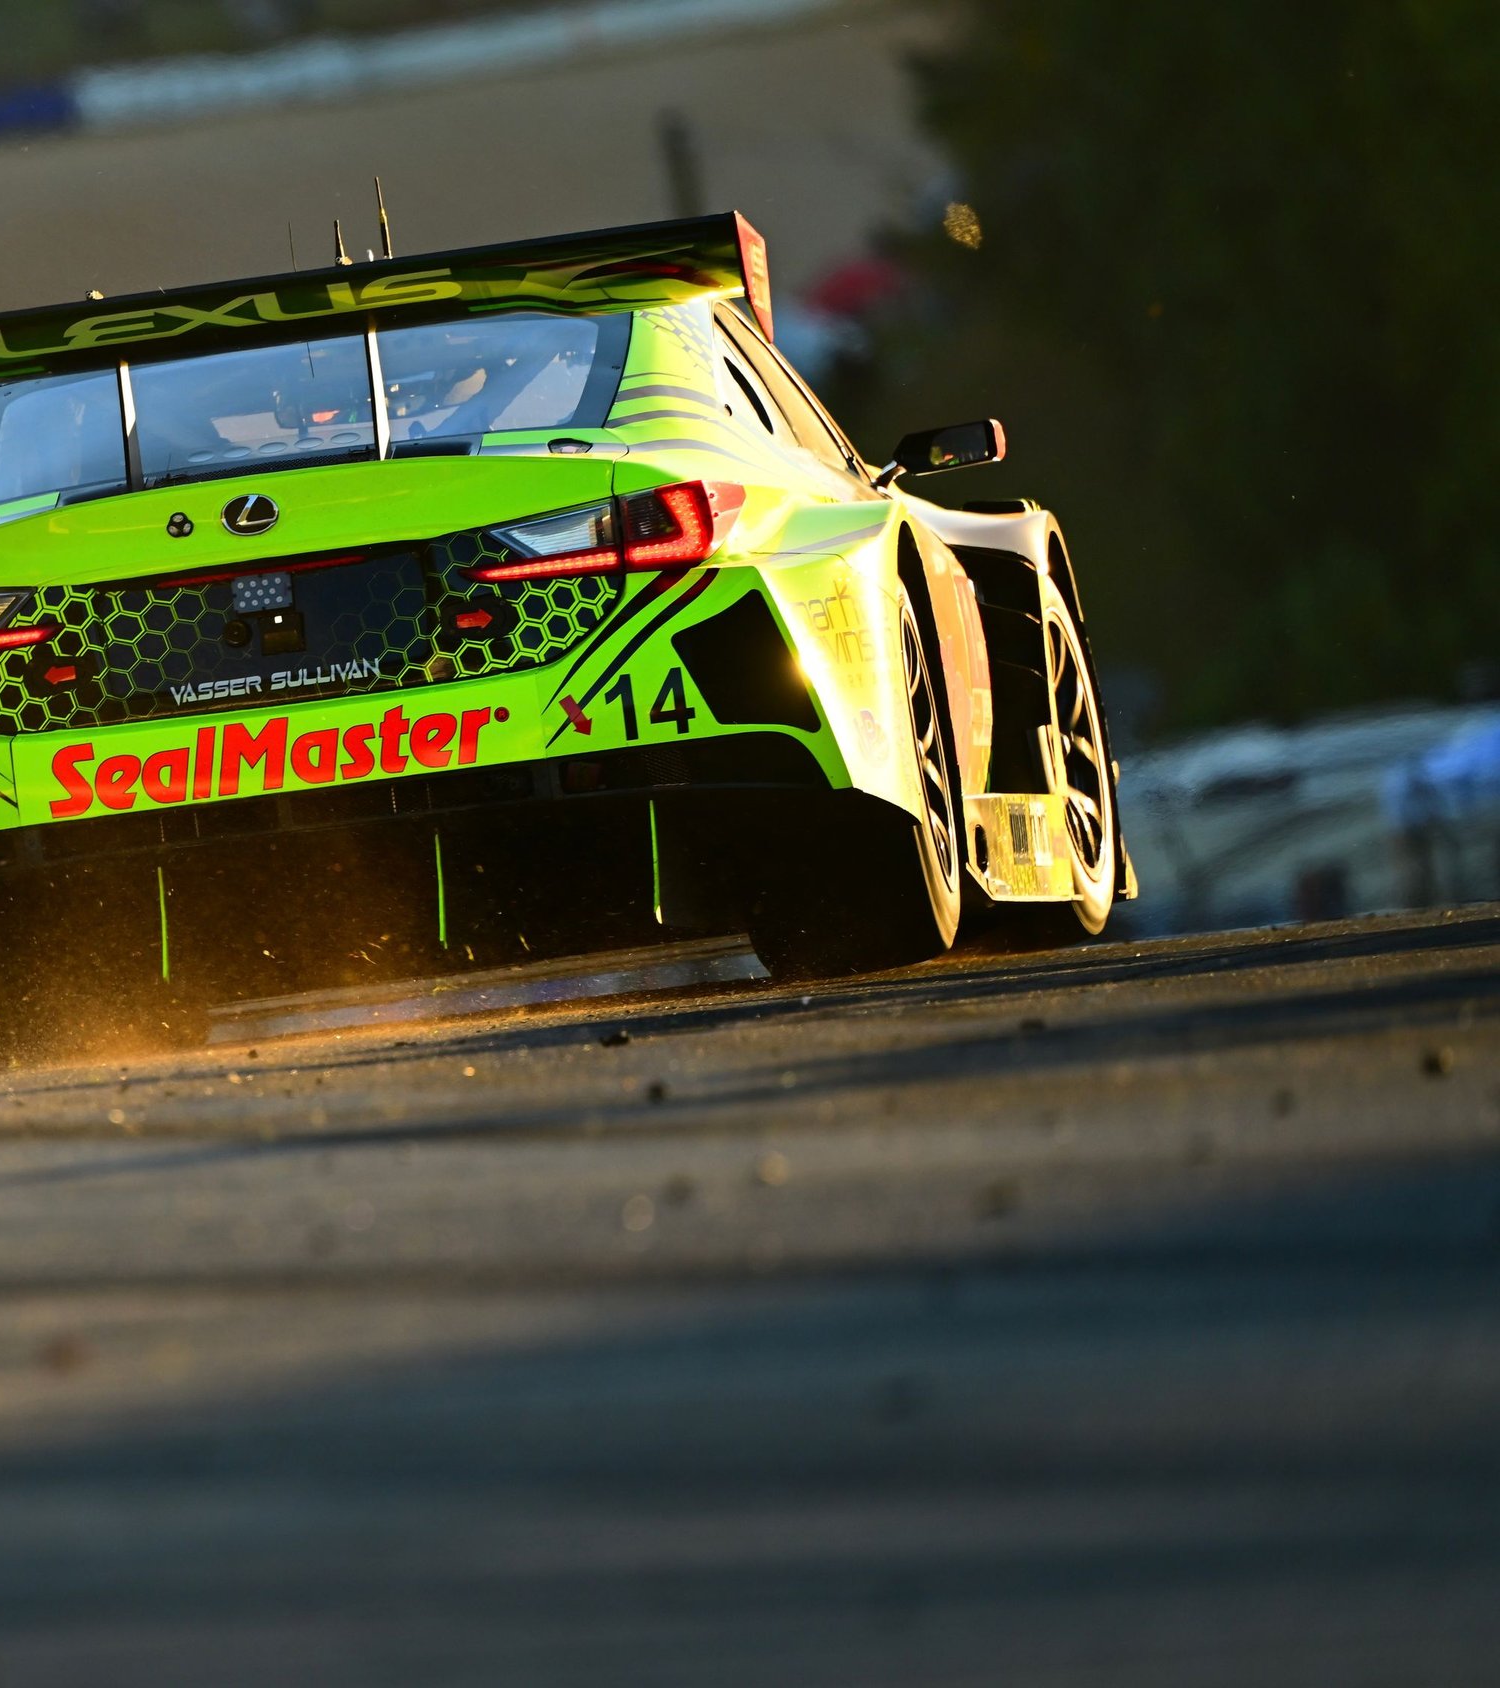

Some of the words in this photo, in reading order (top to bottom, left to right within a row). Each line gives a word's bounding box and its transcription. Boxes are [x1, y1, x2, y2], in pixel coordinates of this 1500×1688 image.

[170, 675, 262, 706] VASSER
[270, 657, 380, 691] SULLIVAN
[604, 667, 696, 741] 14
